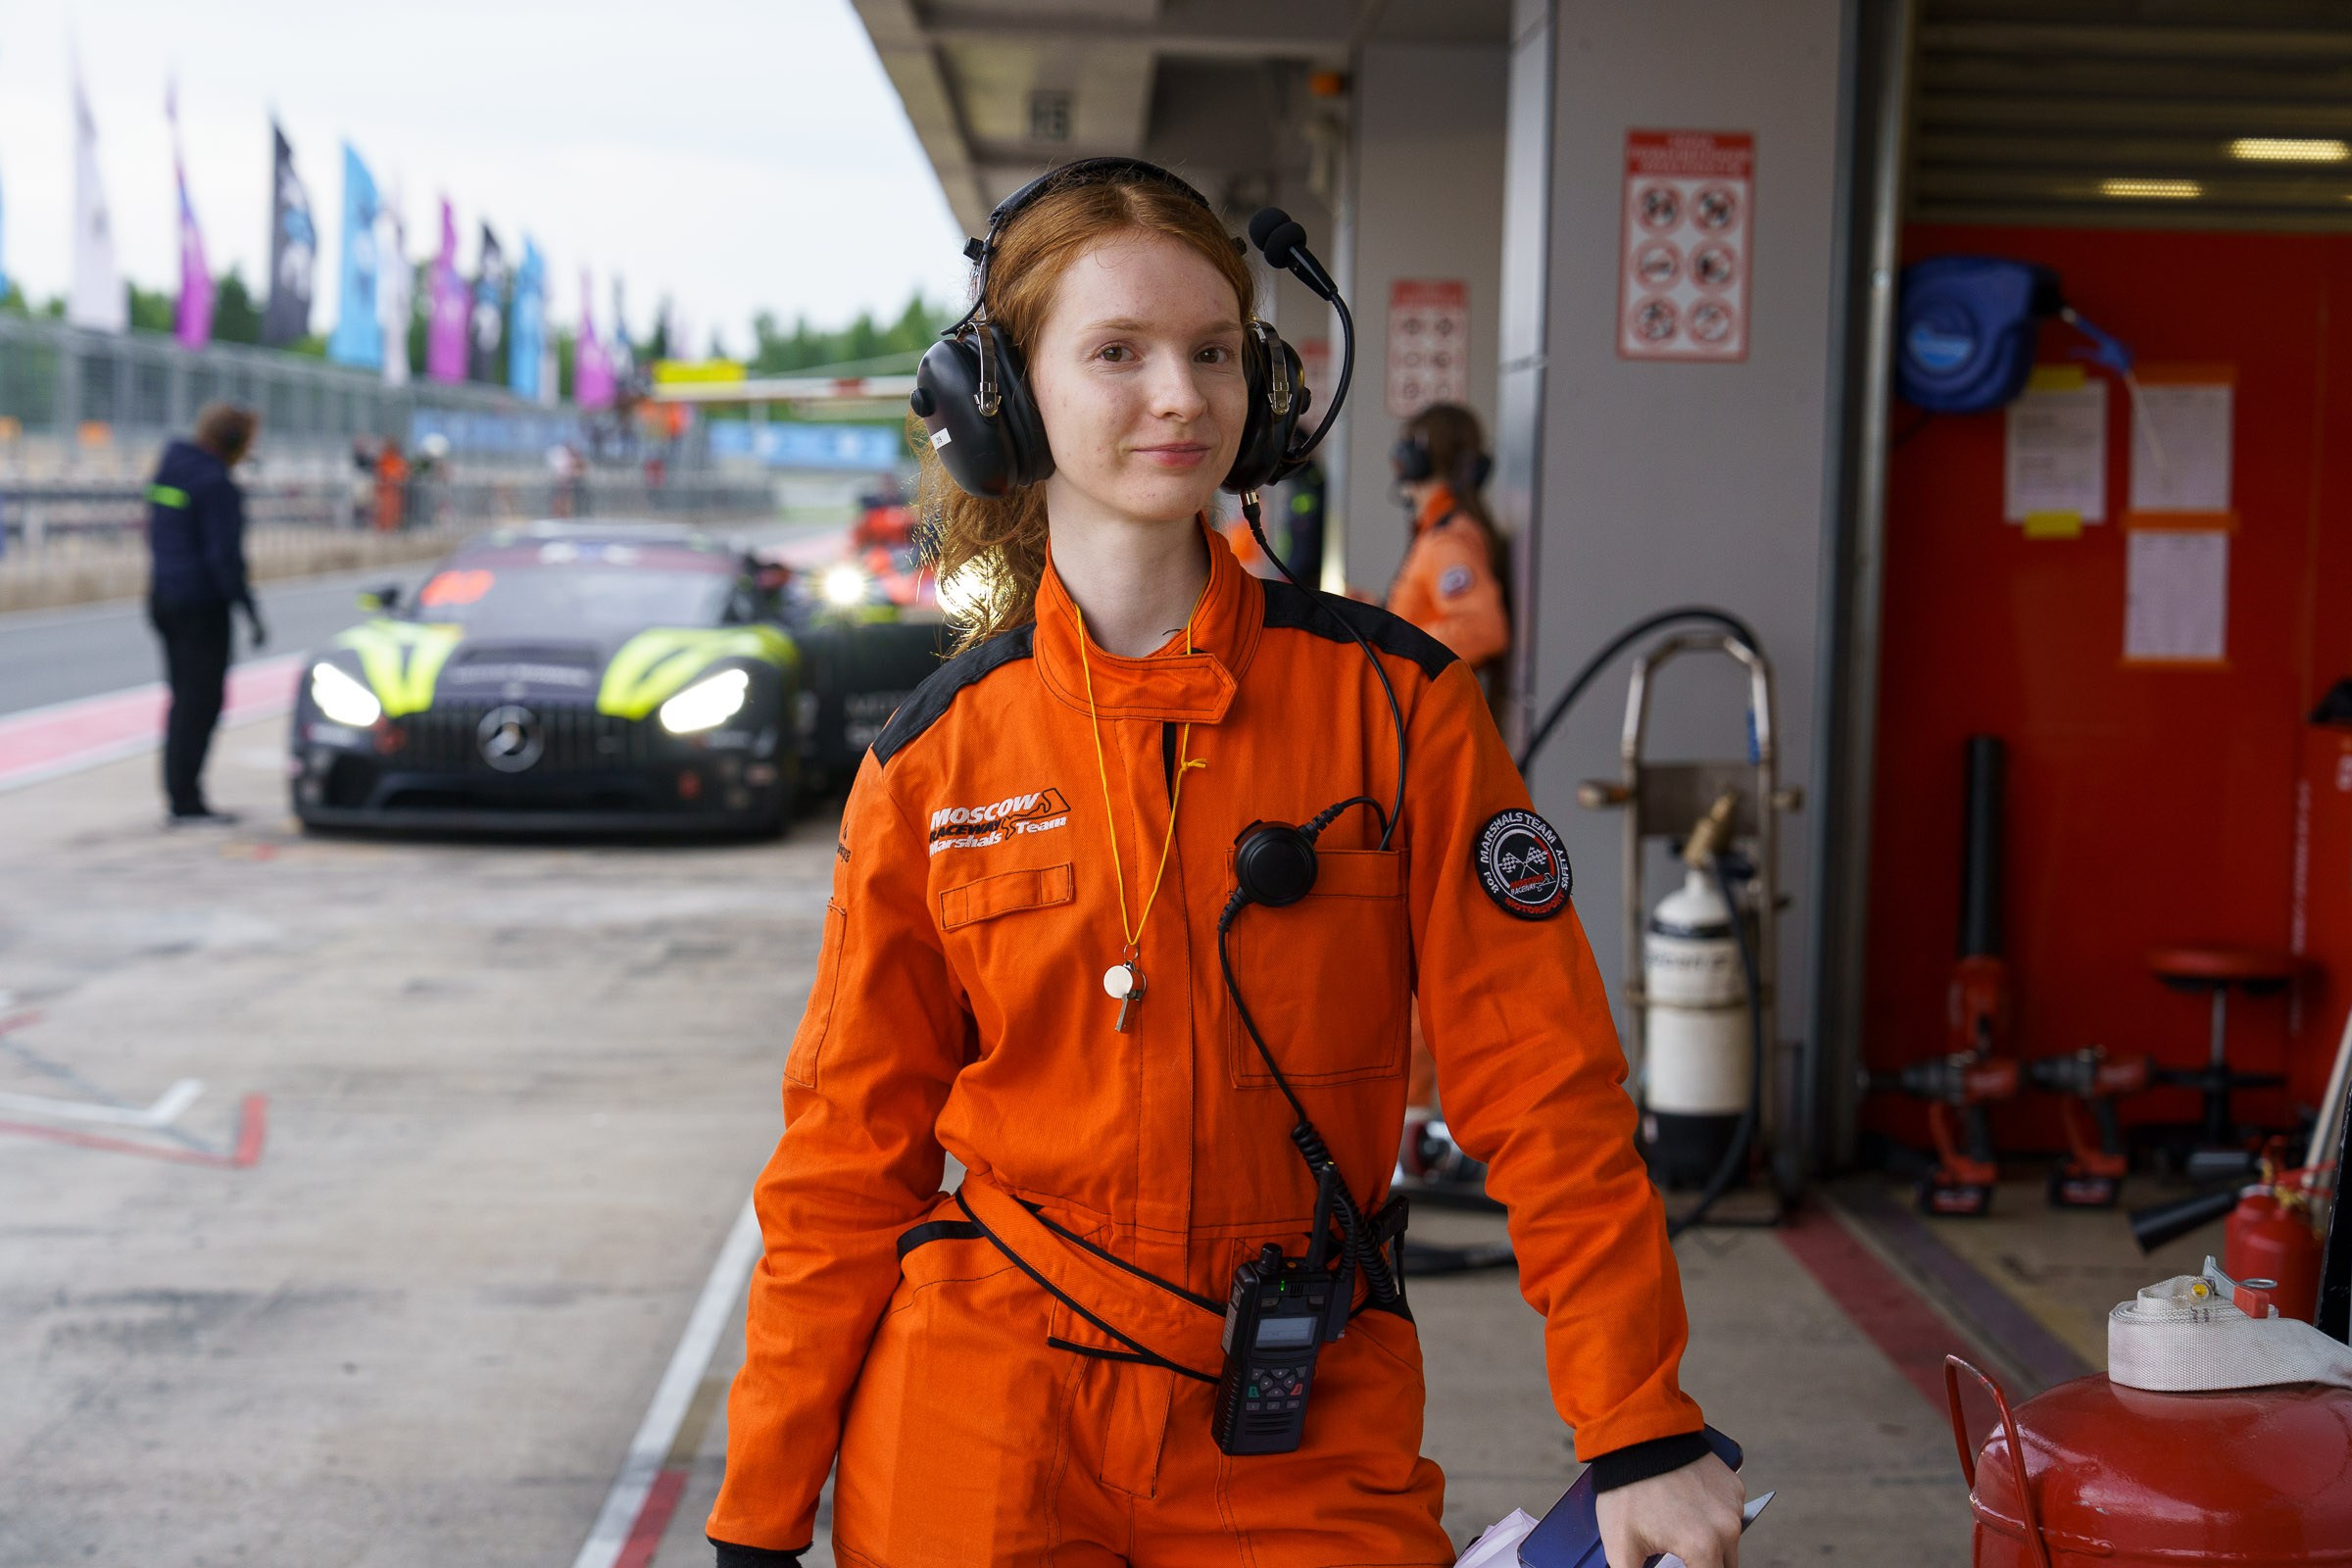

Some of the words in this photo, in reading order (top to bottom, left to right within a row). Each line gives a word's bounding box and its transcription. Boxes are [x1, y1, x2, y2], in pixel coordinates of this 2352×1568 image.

[929, 819, 1002, 843] RACEWAY
[930, 793, 1041, 830] MOSCOW
[929, 831, 1002, 858] Marshals
[1016, 816, 1067, 834] Team
[1480, 811, 1523, 863] MARSHALS
[1524, 813, 1557, 844] TEAM
[1483, 871, 1499, 894] FOR
[1504, 889, 1565, 914] MOTORSPORT
[1555, 849, 1570, 890] SAFETY
